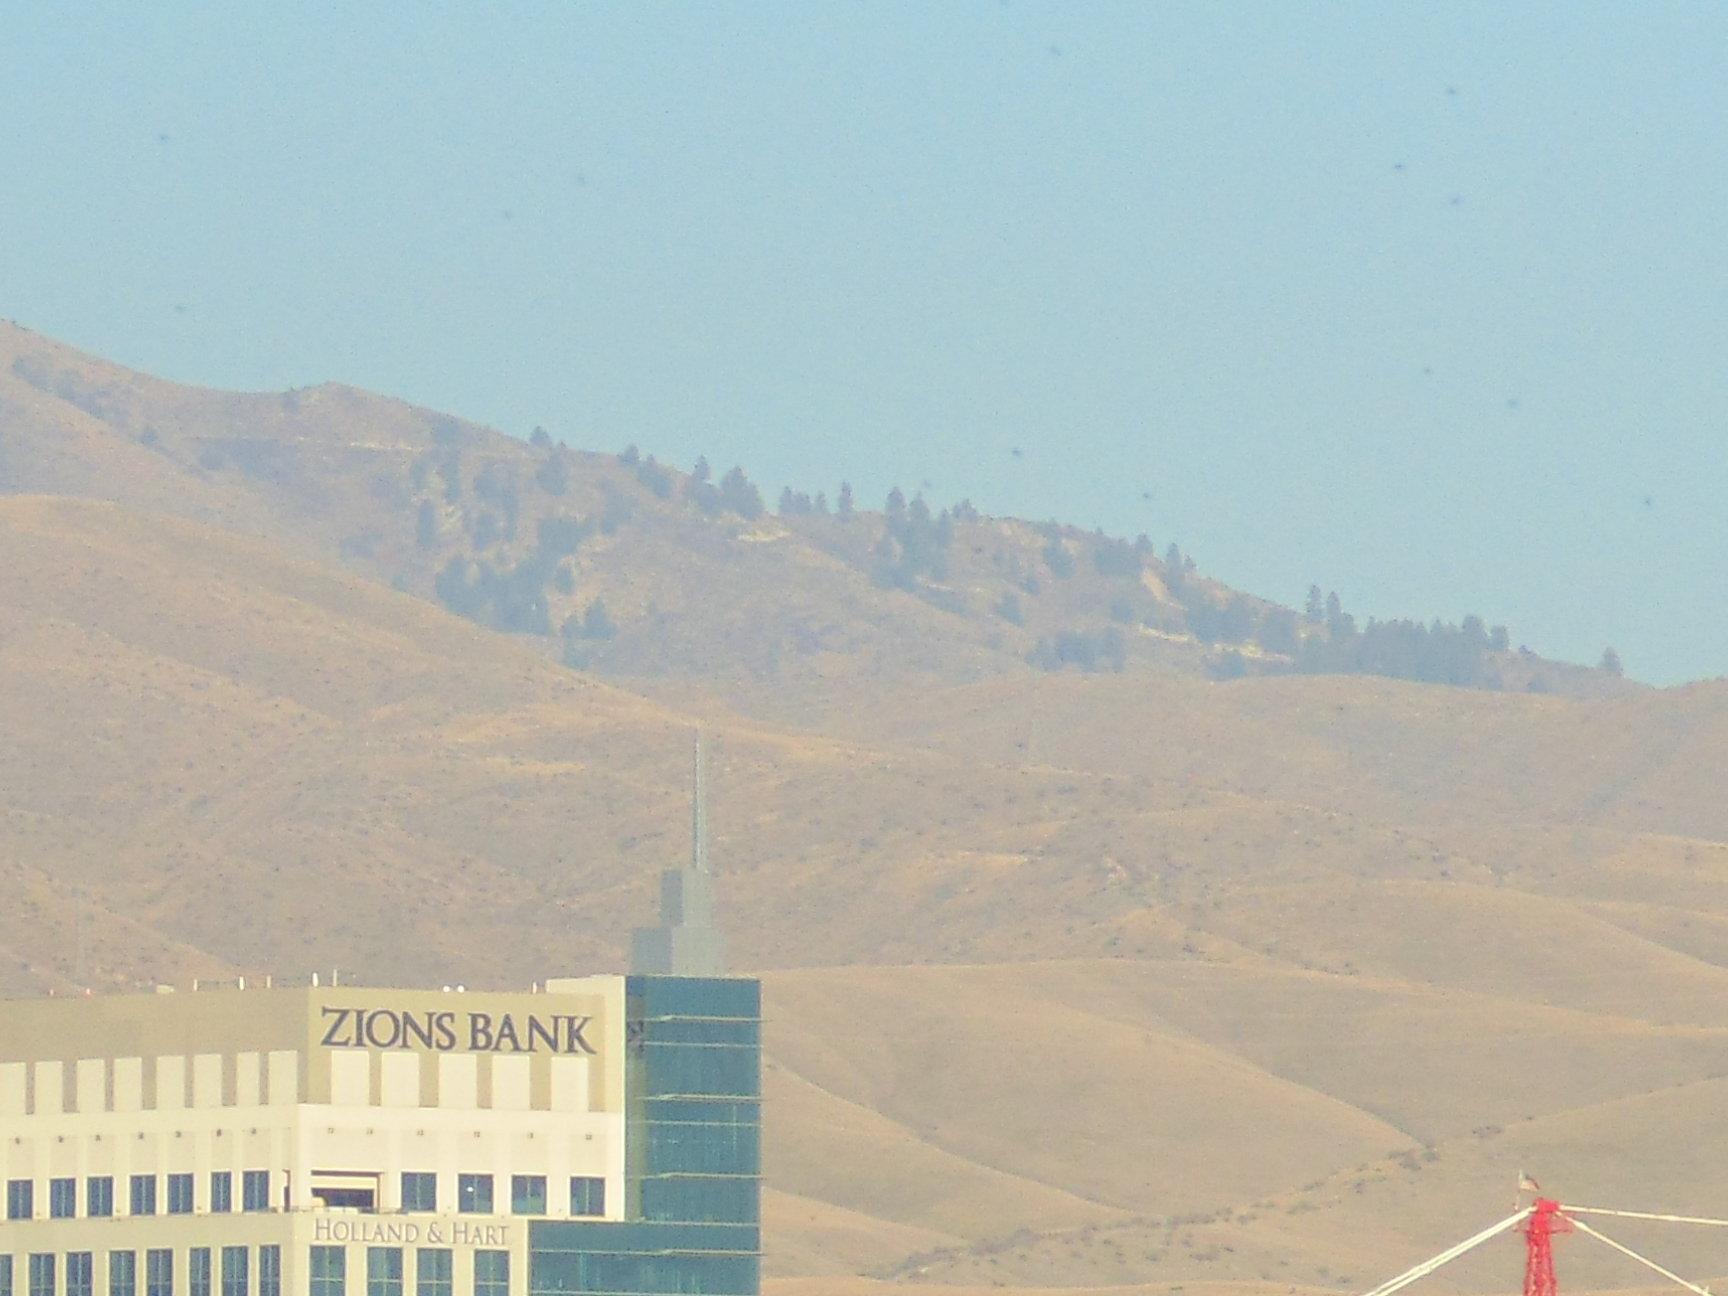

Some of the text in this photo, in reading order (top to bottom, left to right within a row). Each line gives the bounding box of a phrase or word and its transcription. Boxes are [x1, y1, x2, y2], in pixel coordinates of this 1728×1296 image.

[320, 1006, 598, 1055] ZIONS BANK
[314, 1217, 510, 1246] HOLLAND & HART
